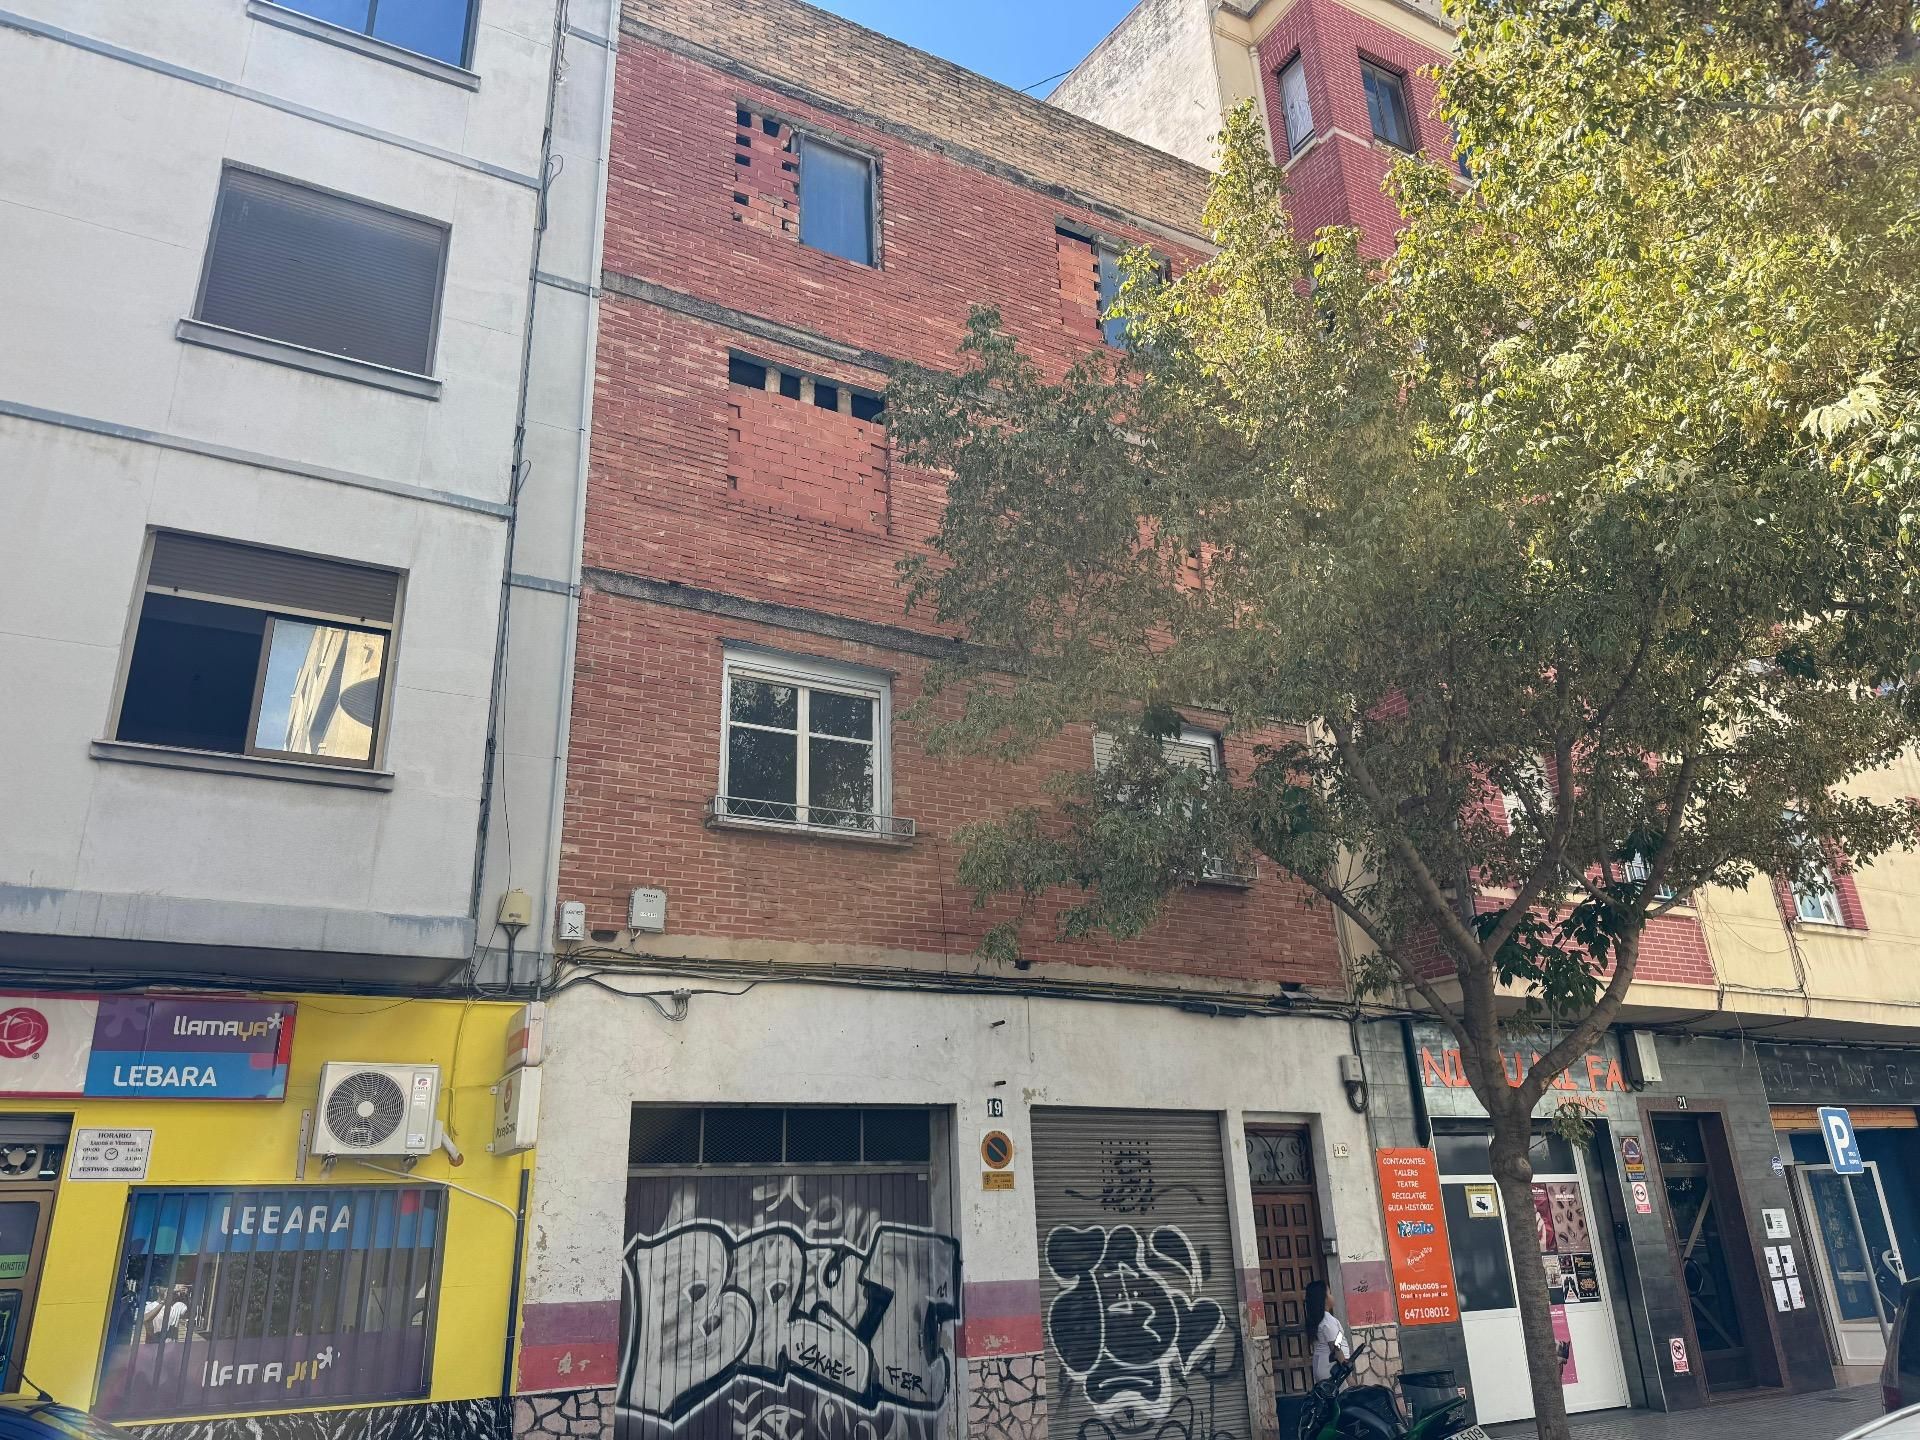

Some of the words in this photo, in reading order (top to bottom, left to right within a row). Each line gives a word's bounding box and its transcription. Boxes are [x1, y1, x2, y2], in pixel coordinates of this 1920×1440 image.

[174, 1015, 268, 1042] llamaya
[113, 1065, 217, 1087] LEBARA
[1421, 1046, 1471, 1087] NI
[1585, 1055, 1628, 1092] FA
[987, 1100, 1002, 1115] 19
[1677, 1096, 1688, 1109] 21
[1828, 1115, 1850, 1166] P
[1396, 1180, 1420, 1188] TEATRE
[1404, 1306, 1451, 1319] 647108012
